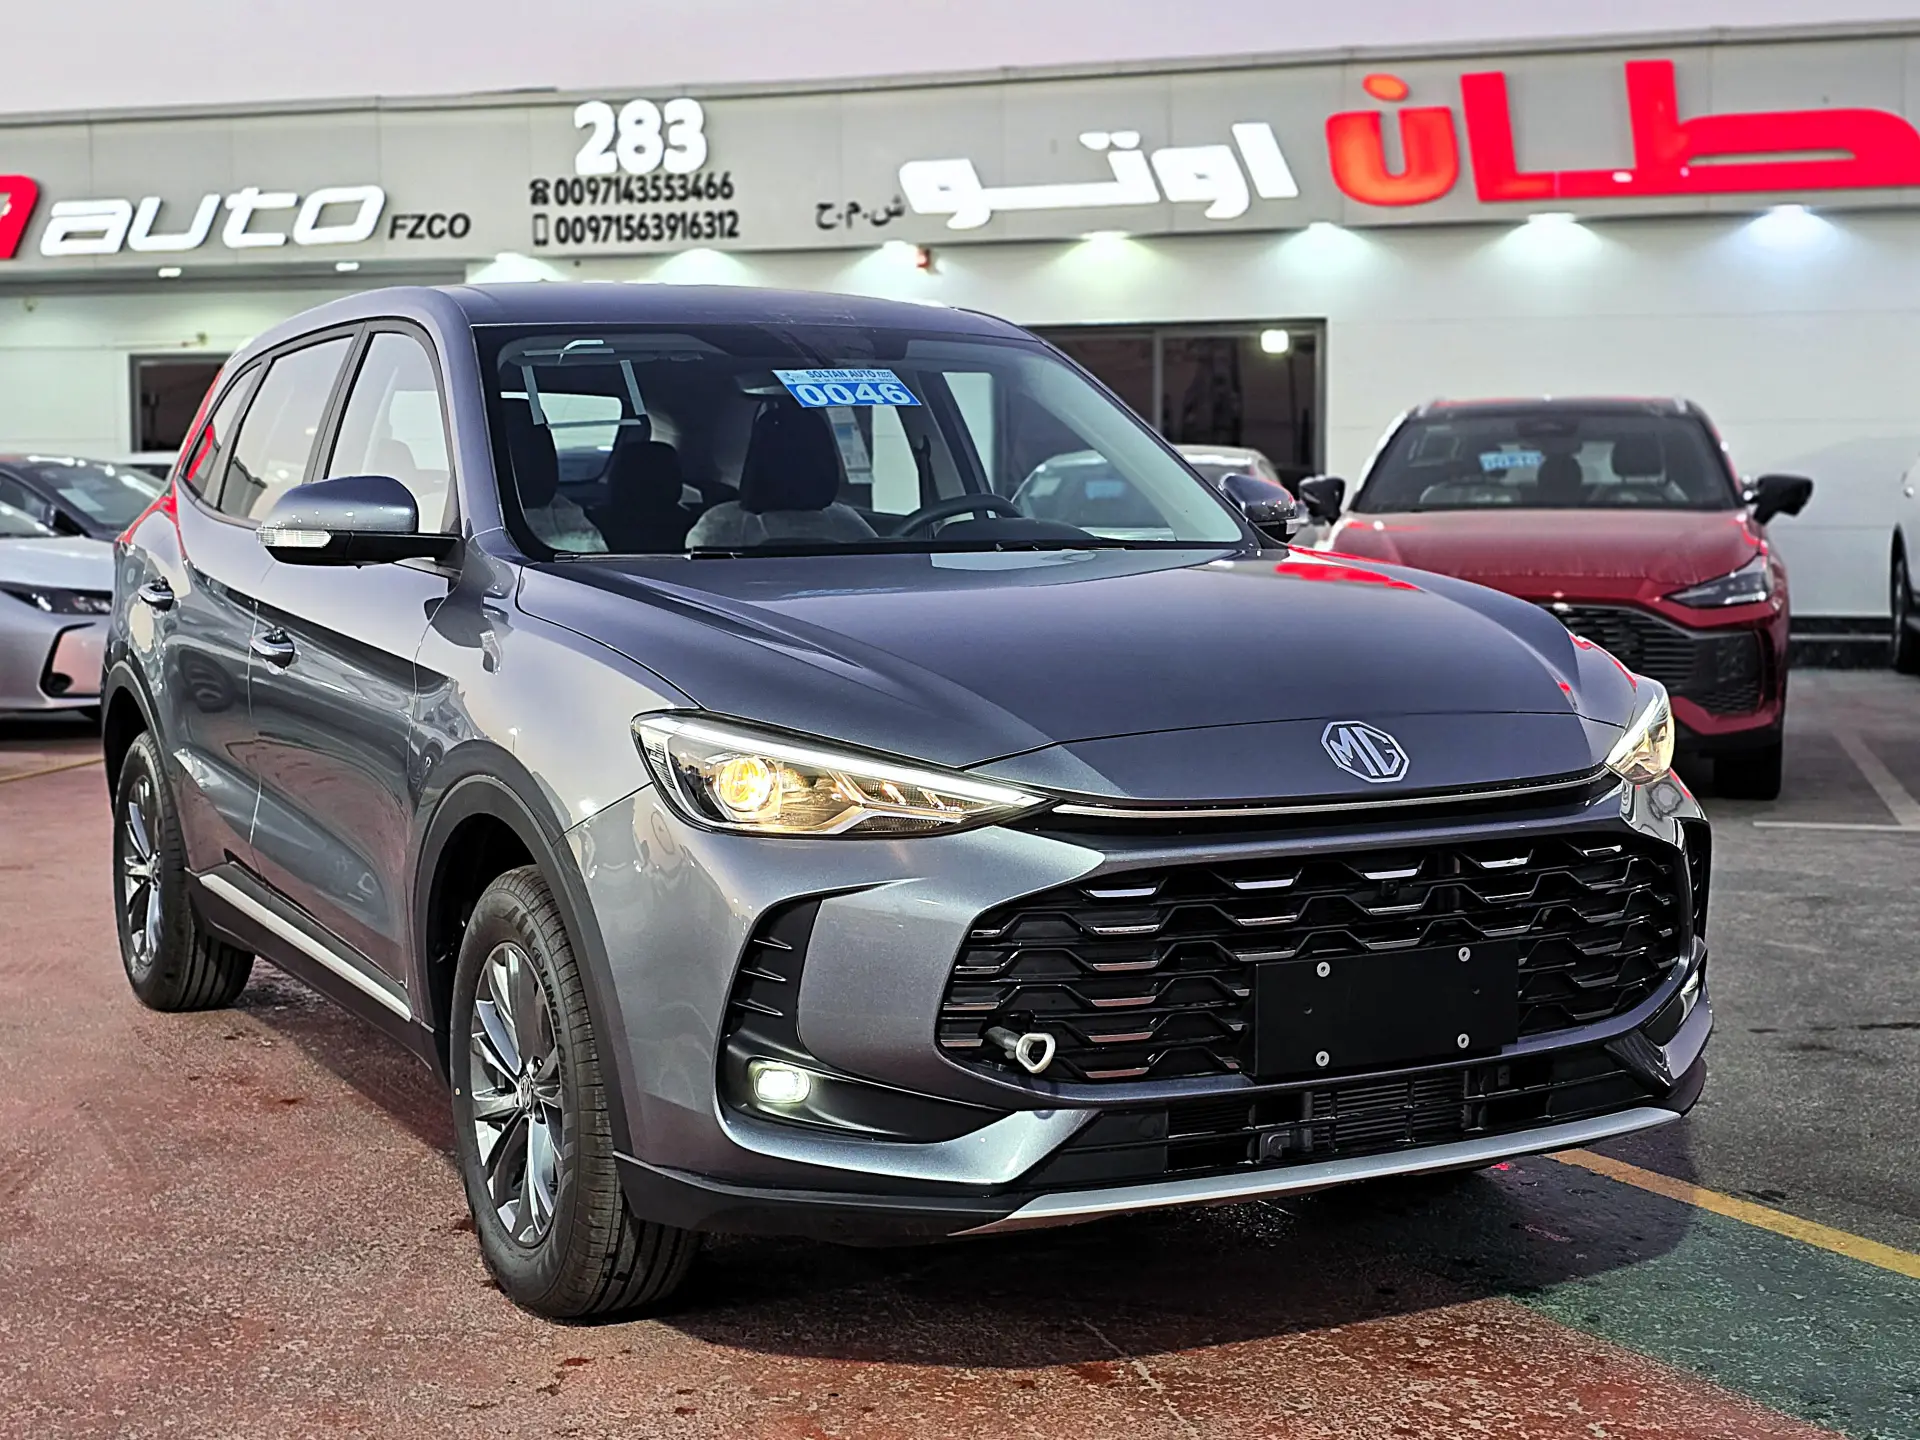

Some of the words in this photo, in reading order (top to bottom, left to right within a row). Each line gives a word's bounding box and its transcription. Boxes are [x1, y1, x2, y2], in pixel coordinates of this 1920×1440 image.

[574, 98, 707, 175] 283
[554, 173, 734, 206] 0097143553466
[40, 186, 385, 256] auto
[389, 213, 471, 239] FZCO
[555, 210, 739, 244] 00971563916312
[806, 370, 848, 378] SOLTAN
[848, 370, 876, 378] AUTO
[796, 383, 911, 406] 0046
[1329, 726, 1401, 776] MG
